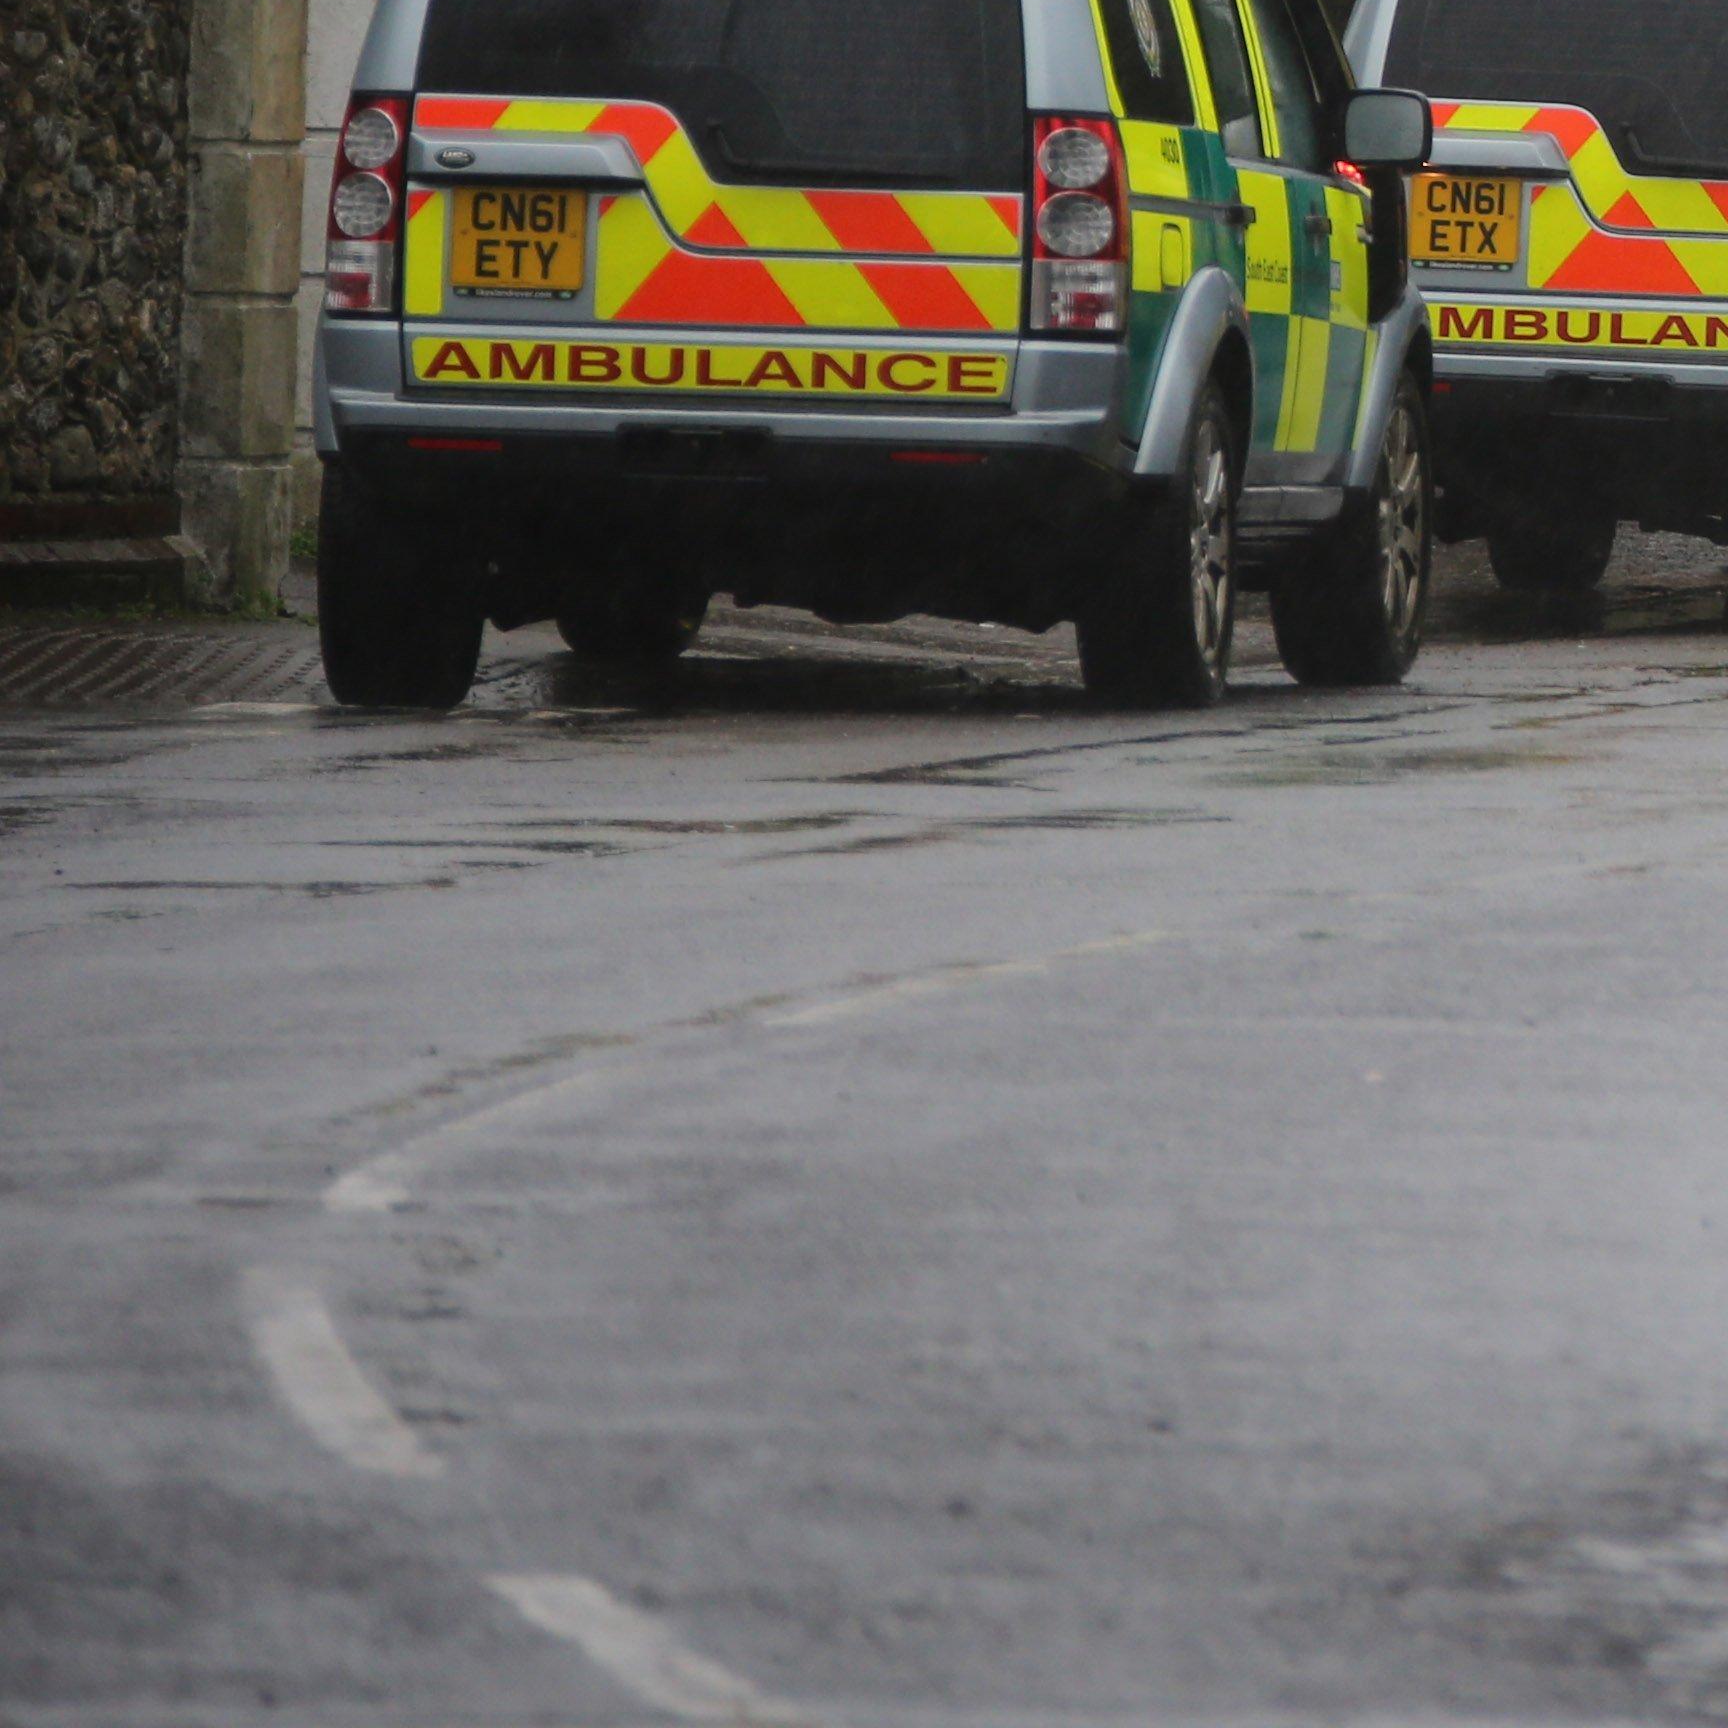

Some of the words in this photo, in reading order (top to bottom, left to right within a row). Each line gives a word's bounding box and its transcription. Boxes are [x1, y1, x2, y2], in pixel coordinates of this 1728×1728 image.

[471, 191, 567, 233] CN61
[1427, 180, 1505, 215] CN61
[1430, 219, 1498, 254] ETX
[474, 238, 559, 280] ETY
[421, 340, 998, 394] AMBULANCE
